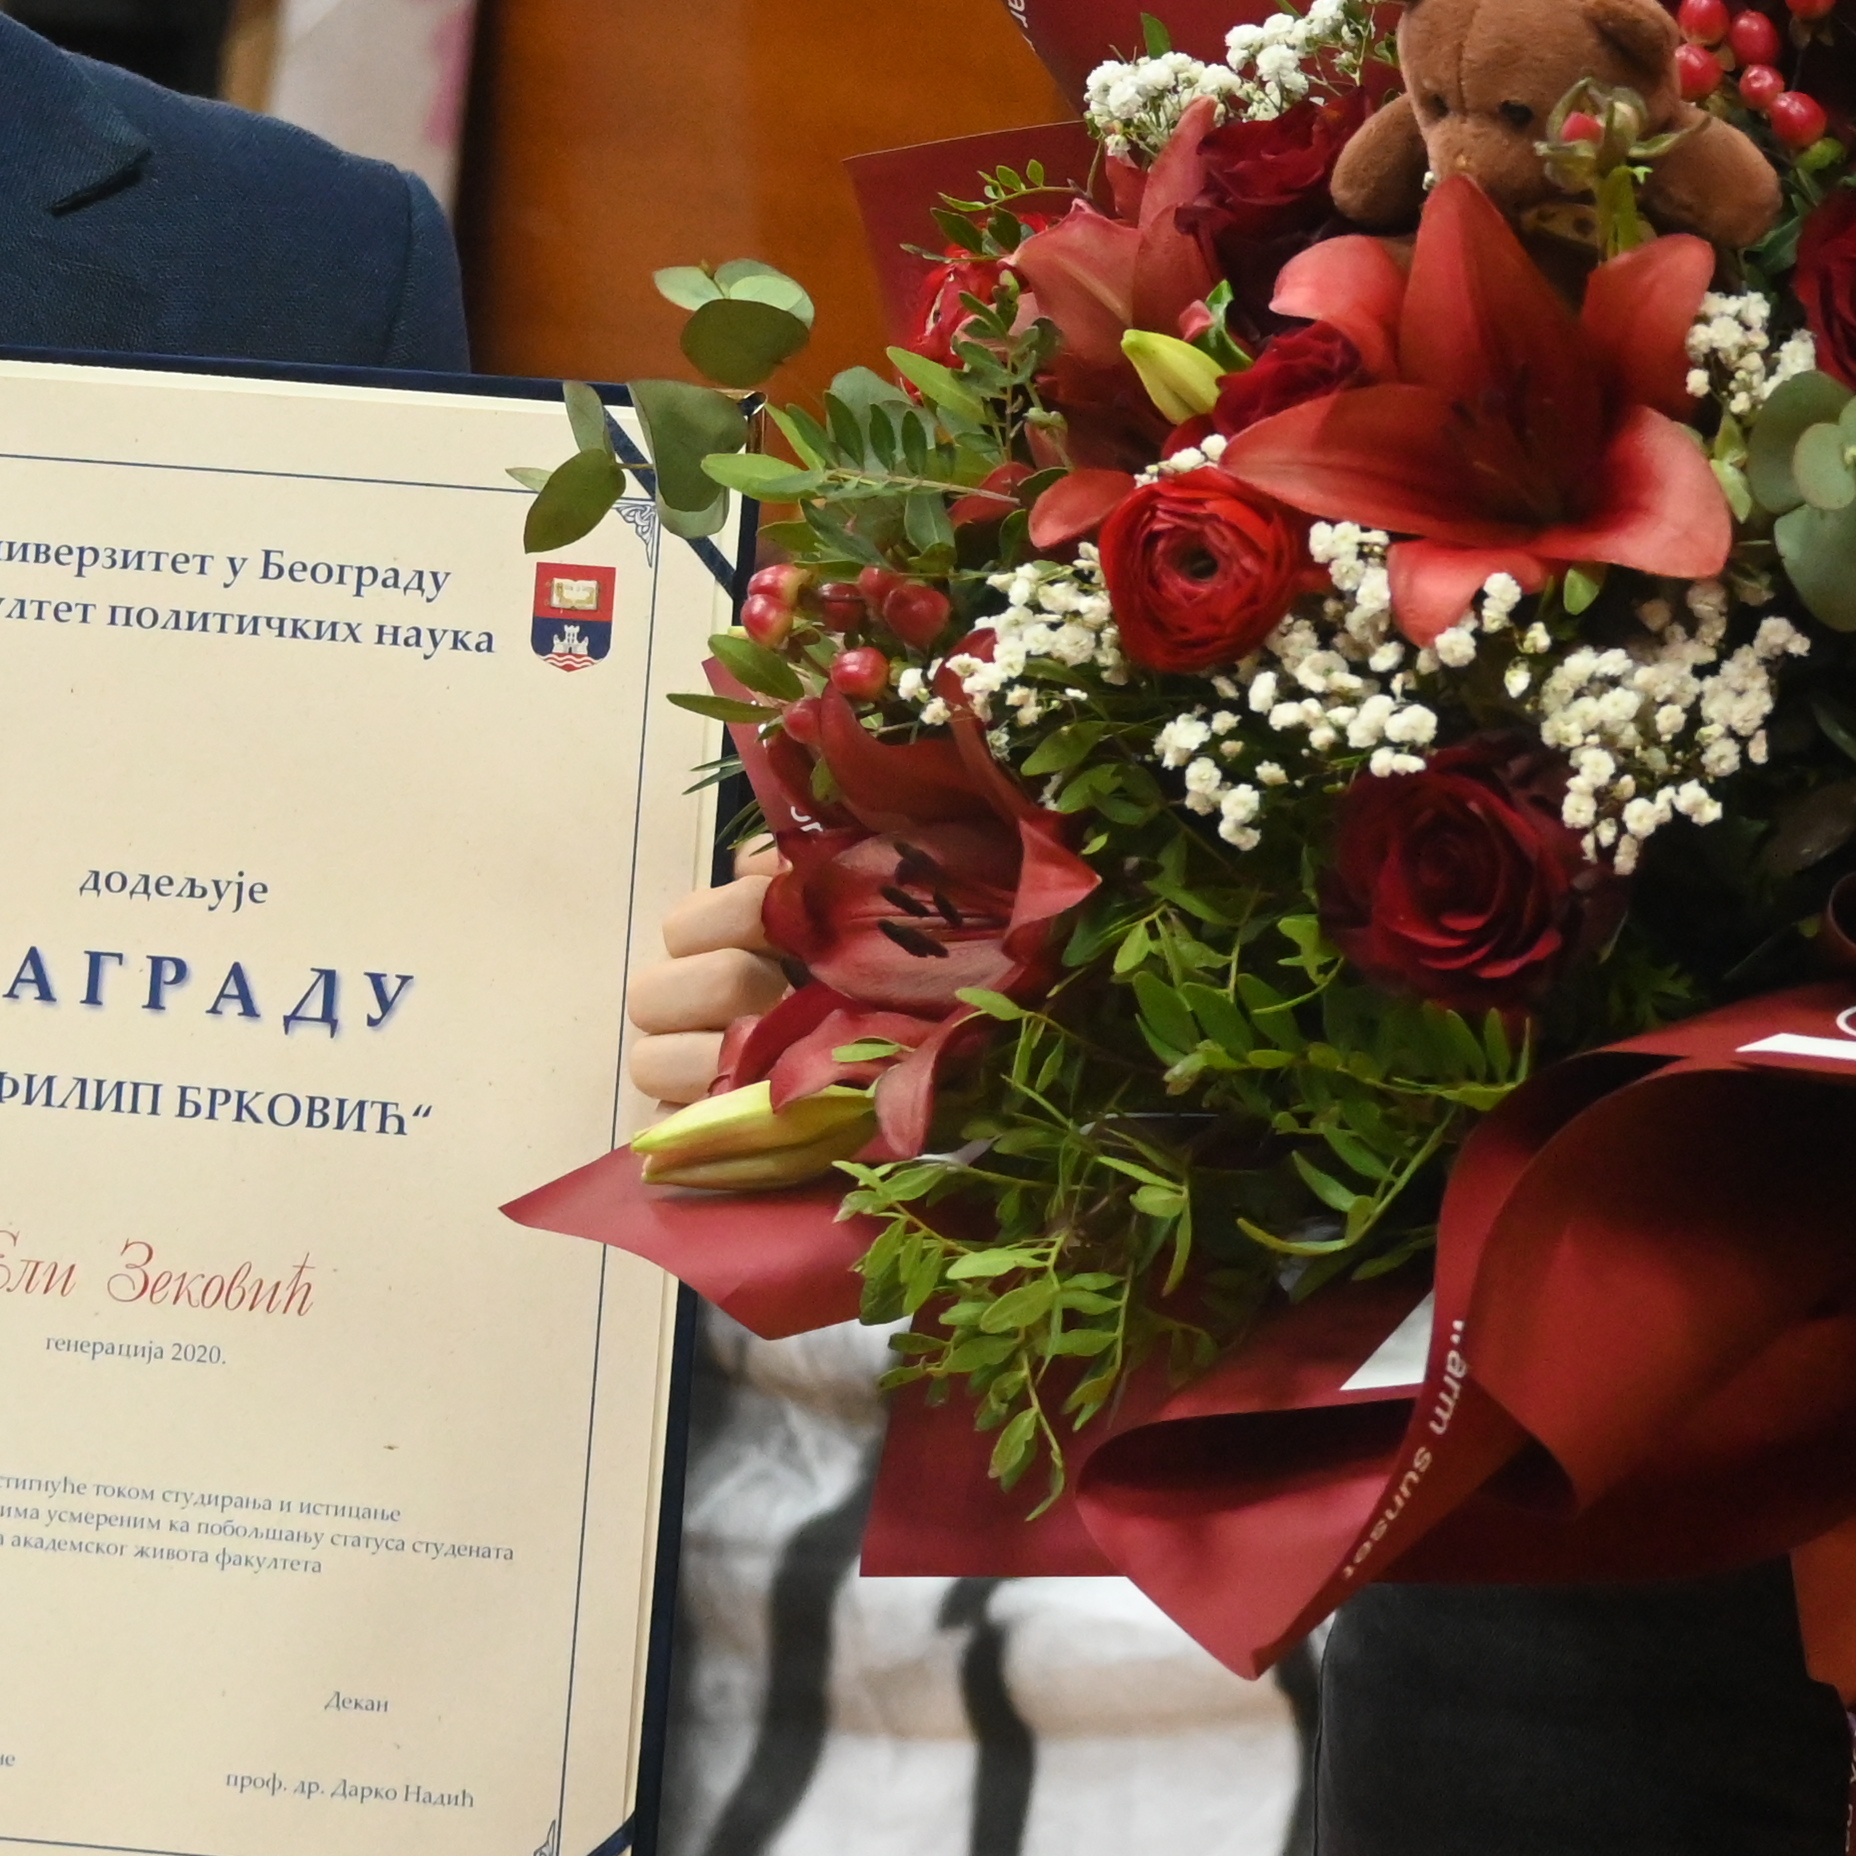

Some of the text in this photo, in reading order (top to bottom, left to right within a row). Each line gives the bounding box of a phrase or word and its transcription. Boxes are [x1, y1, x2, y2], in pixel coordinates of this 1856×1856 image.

[222, 555, 249, 589] у
[258, 548, 452, 604] Београду
[106, 593, 365, 644] политичких
[373, 623, 495, 661] наука
[78, 869, 269, 914] додељује
[106, 1237, 316, 1317] Зековић
[45, 1334, 226, 1365] генерација 2020.
[92, 1483, 155, 1502] током
[161, 1489, 273, 1514] студирања
[279, 1499, 293, 1514] и
[298, 1501, 402, 1523] истицање
[10, 1534, 129, 1557] академског
[132, 1544, 209, 1564] живота
[214, 1546, 322, 1575] факултета
[44, 1508, 161, 1533] усмереним
[168, 1518, 190, 1534] ка
[196, 1519, 325, 1551] побољшању
[329, 1533, 406, 1556] статуса
[411, 1540, 514, 1562] студената
[323, 1690, 389, 1713] Декан
[225, 1771, 474, 1809] проф. др. Дарко Надић
